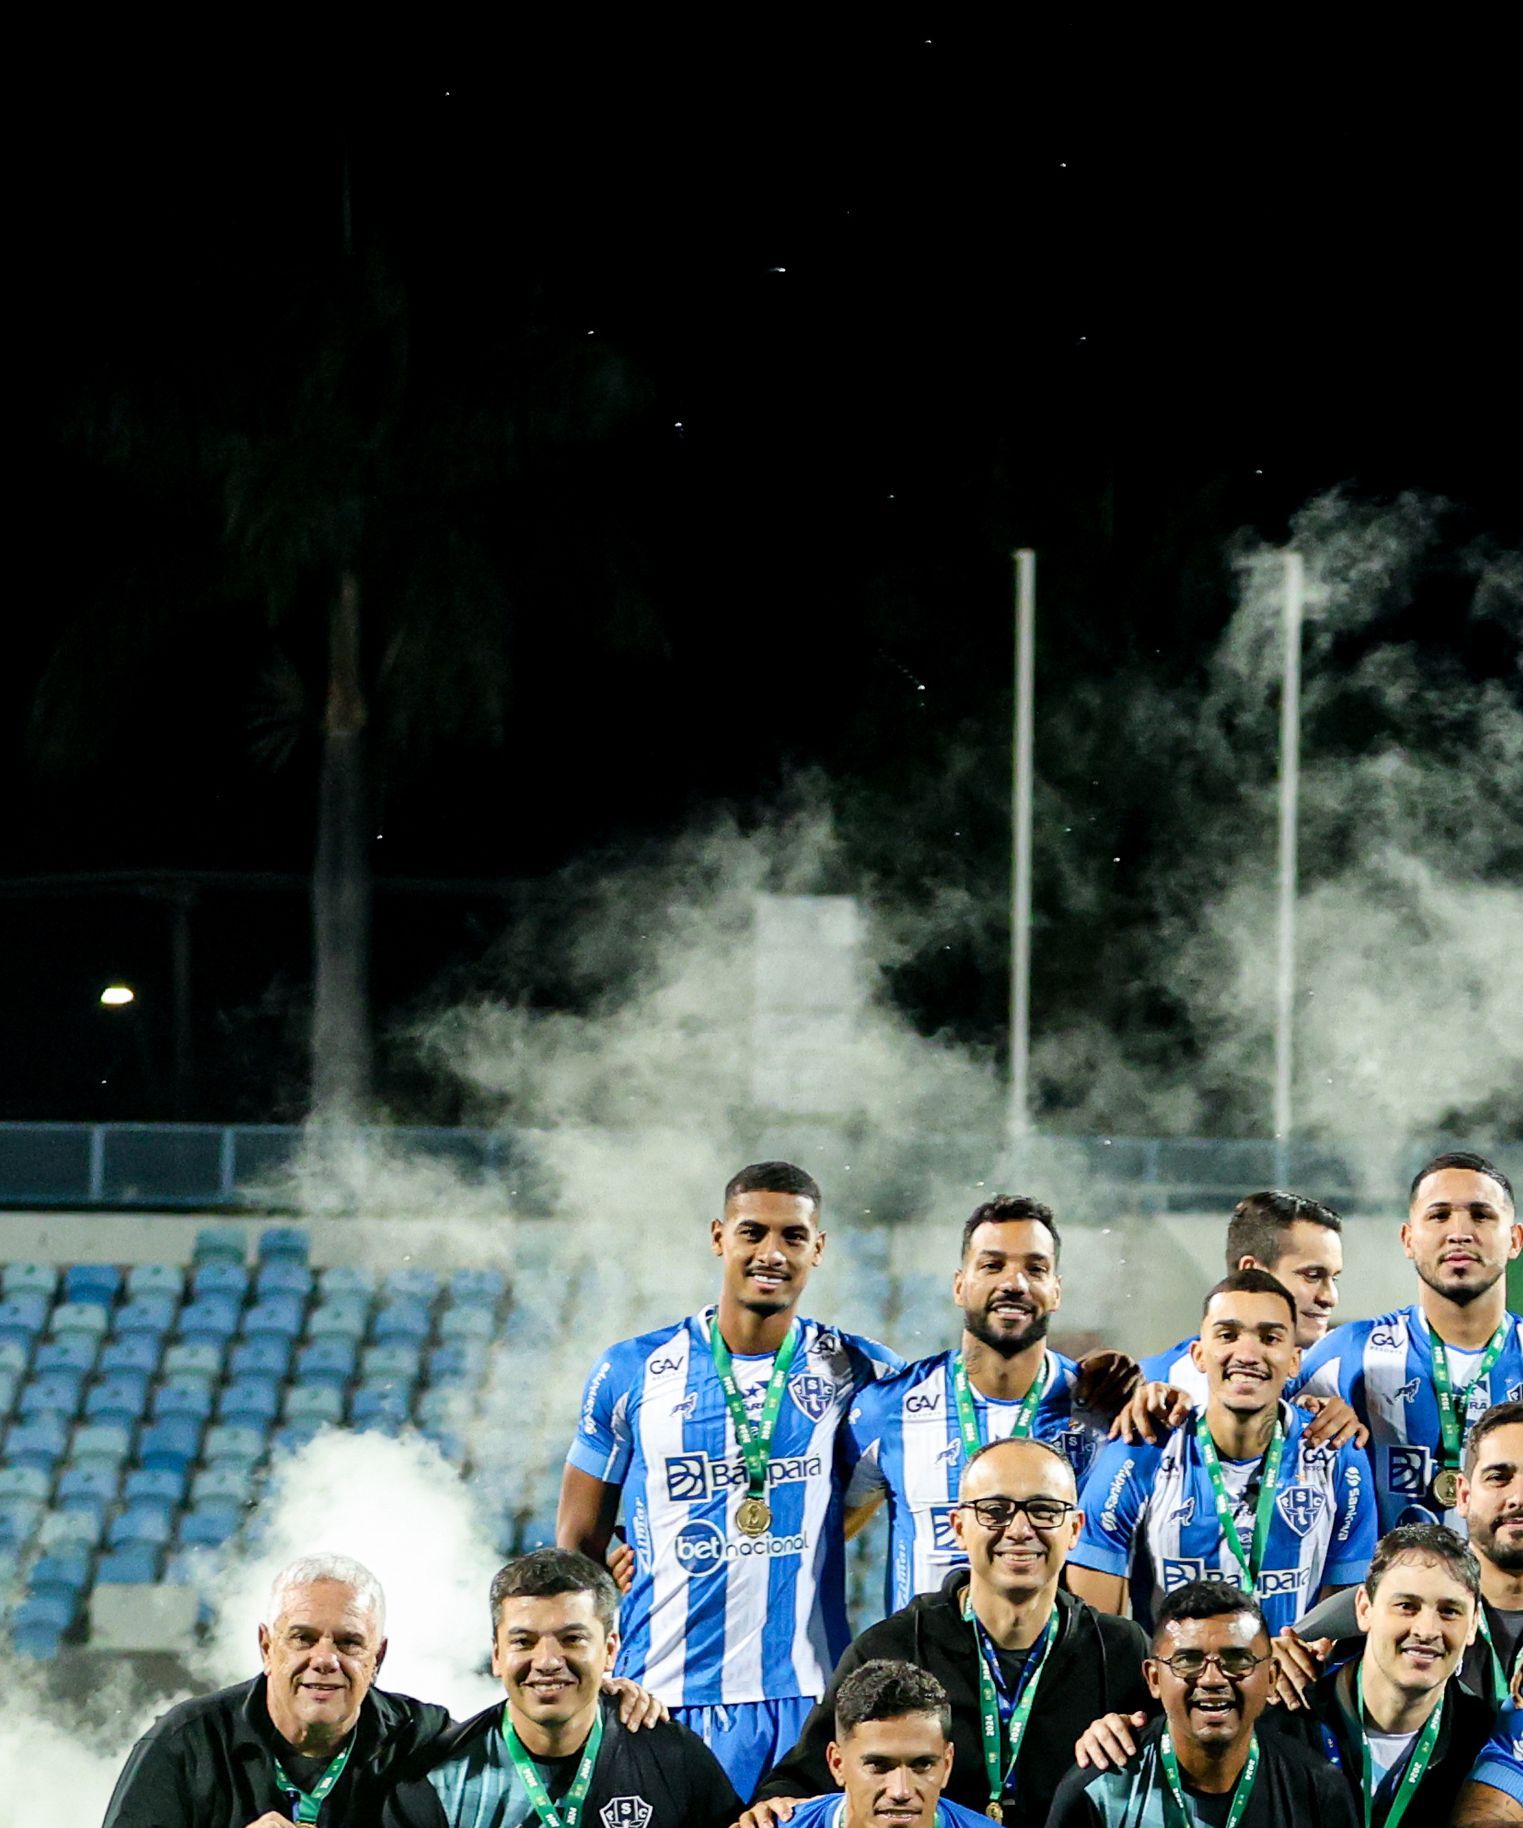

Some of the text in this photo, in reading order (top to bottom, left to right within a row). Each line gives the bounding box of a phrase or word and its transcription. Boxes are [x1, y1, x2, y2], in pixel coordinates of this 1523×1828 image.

[1371, 1333, 1404, 1347] GAV
[650, 1356, 684, 1375] GAV
[906, 1394, 940, 1412] GAV
[711, 1456, 822, 1487] Bapará
[1105, 1458, 1136, 1513] Sankhya
[676, 1532, 809, 1560] bet nacional
[985, 1715, 995, 1737] 2024
[1009, 1721, 1022, 1744] 2024
[1245, 1759, 1256, 1781] 2024
[1408, 1760, 1422, 1785] 2024
[606, 1802, 648, 1821] PSC
